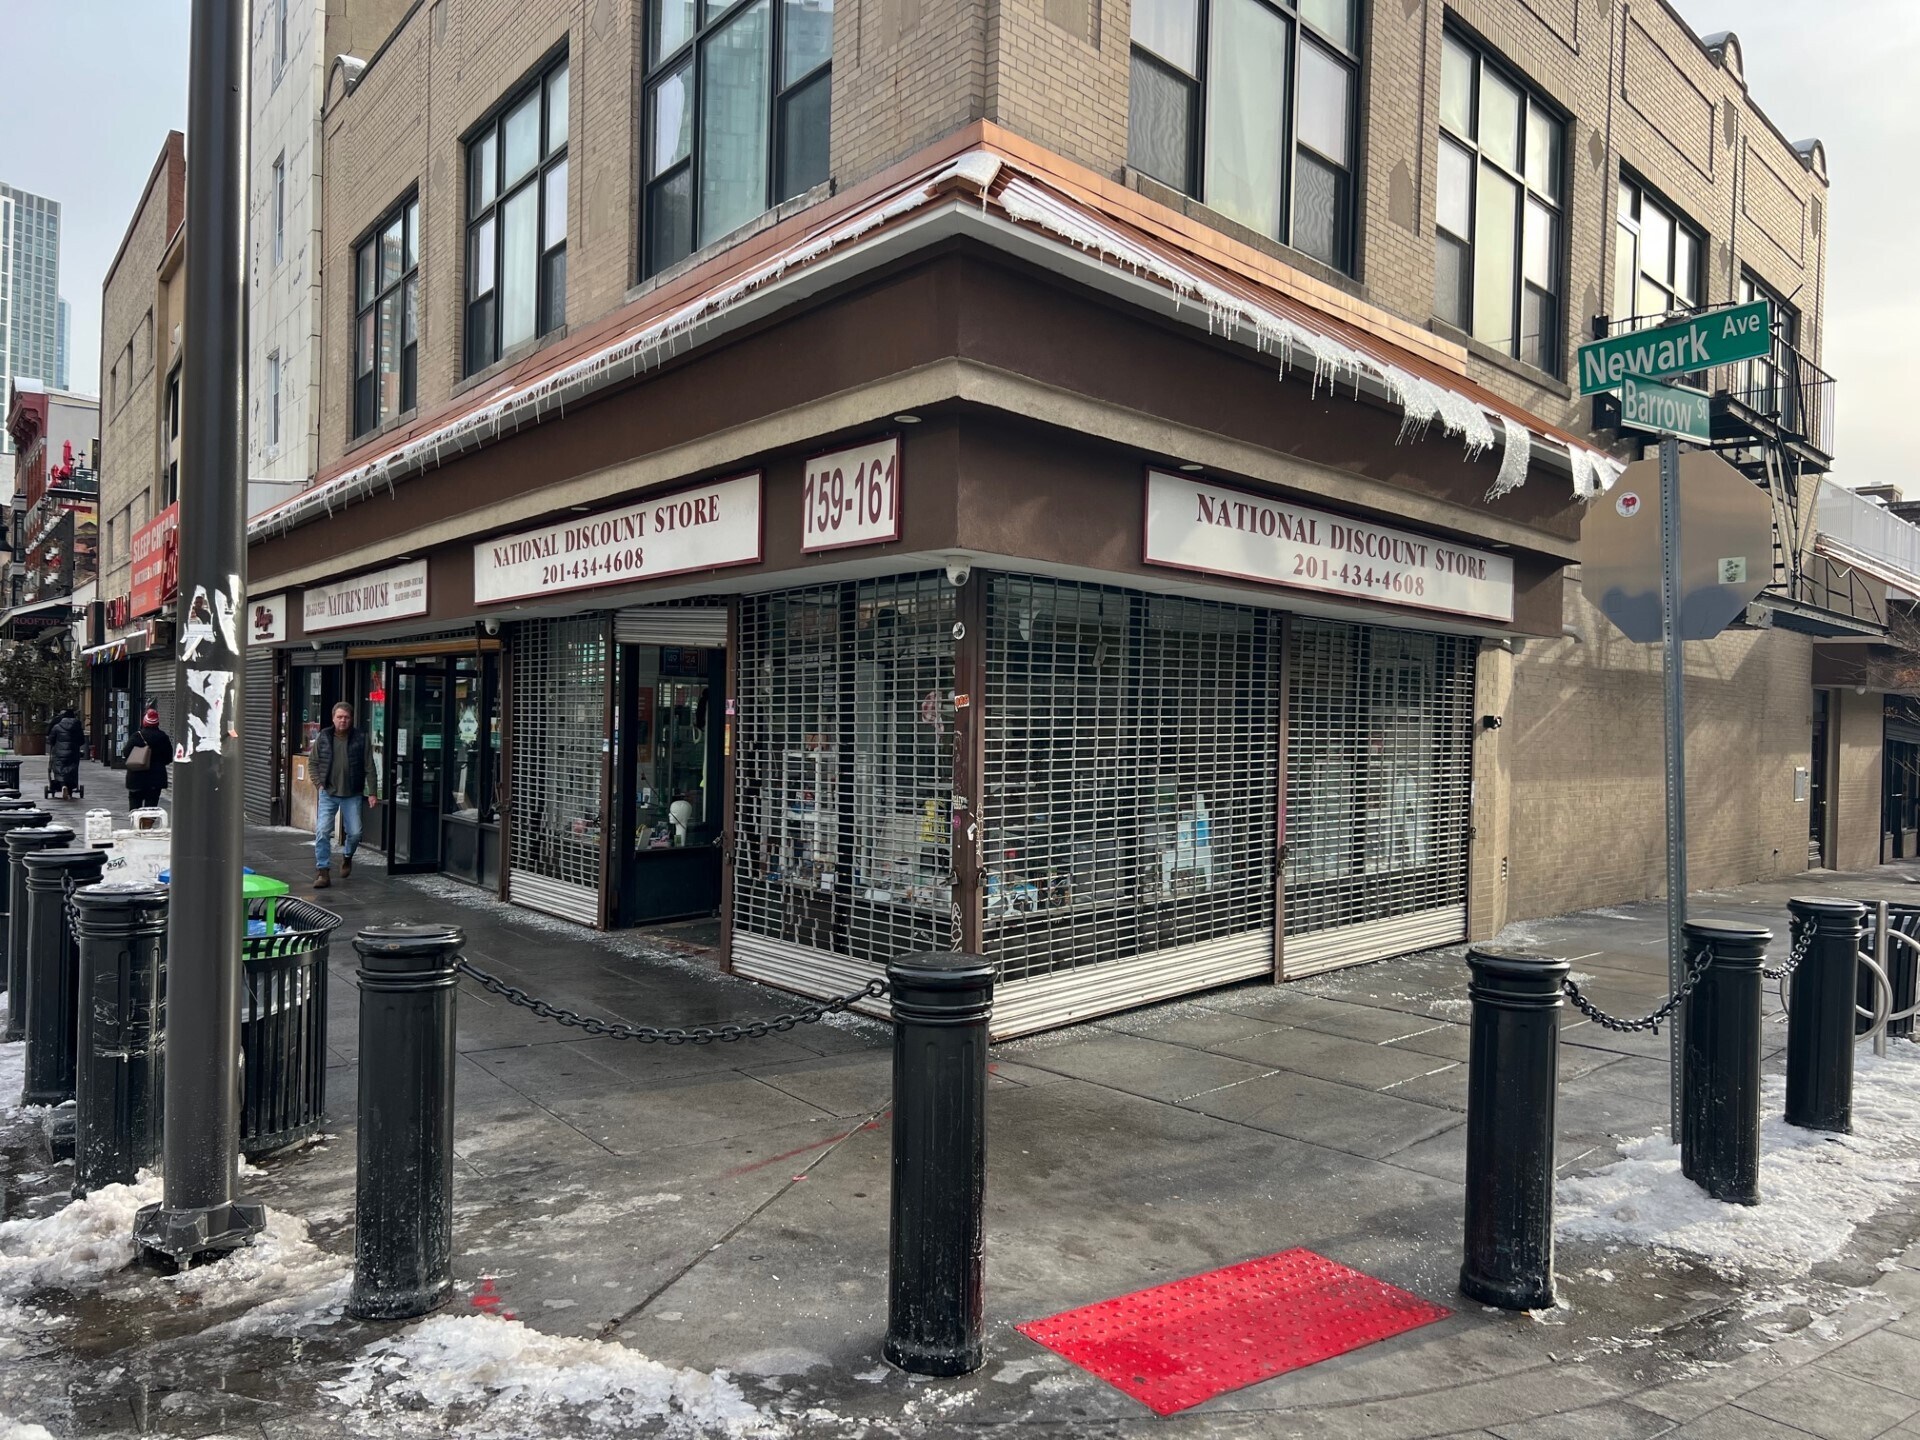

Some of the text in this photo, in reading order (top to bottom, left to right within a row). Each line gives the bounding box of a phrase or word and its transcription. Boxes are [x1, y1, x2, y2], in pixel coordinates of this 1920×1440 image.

[1585, 314, 1760, 387] Newark Ave
[1625, 379, 1707, 432] Barrow St
[804, 454, 896, 533] 159-161
[133, 531, 151, 564] SLEEP
[493, 494, 720, 568] NATIONAL DISCOUNT STORE
[1196, 493, 1487, 580] NATIONAL DISCOUNT STORE
[542, 547, 644, 585] 201-434-4608
[1293, 553, 1424, 596] 201-434-4608
[13, 617, 60, 626] ROOFTOP
[327, 588, 362, 617] NATURE'S
[363, 582, 390, 611] HOUSE
